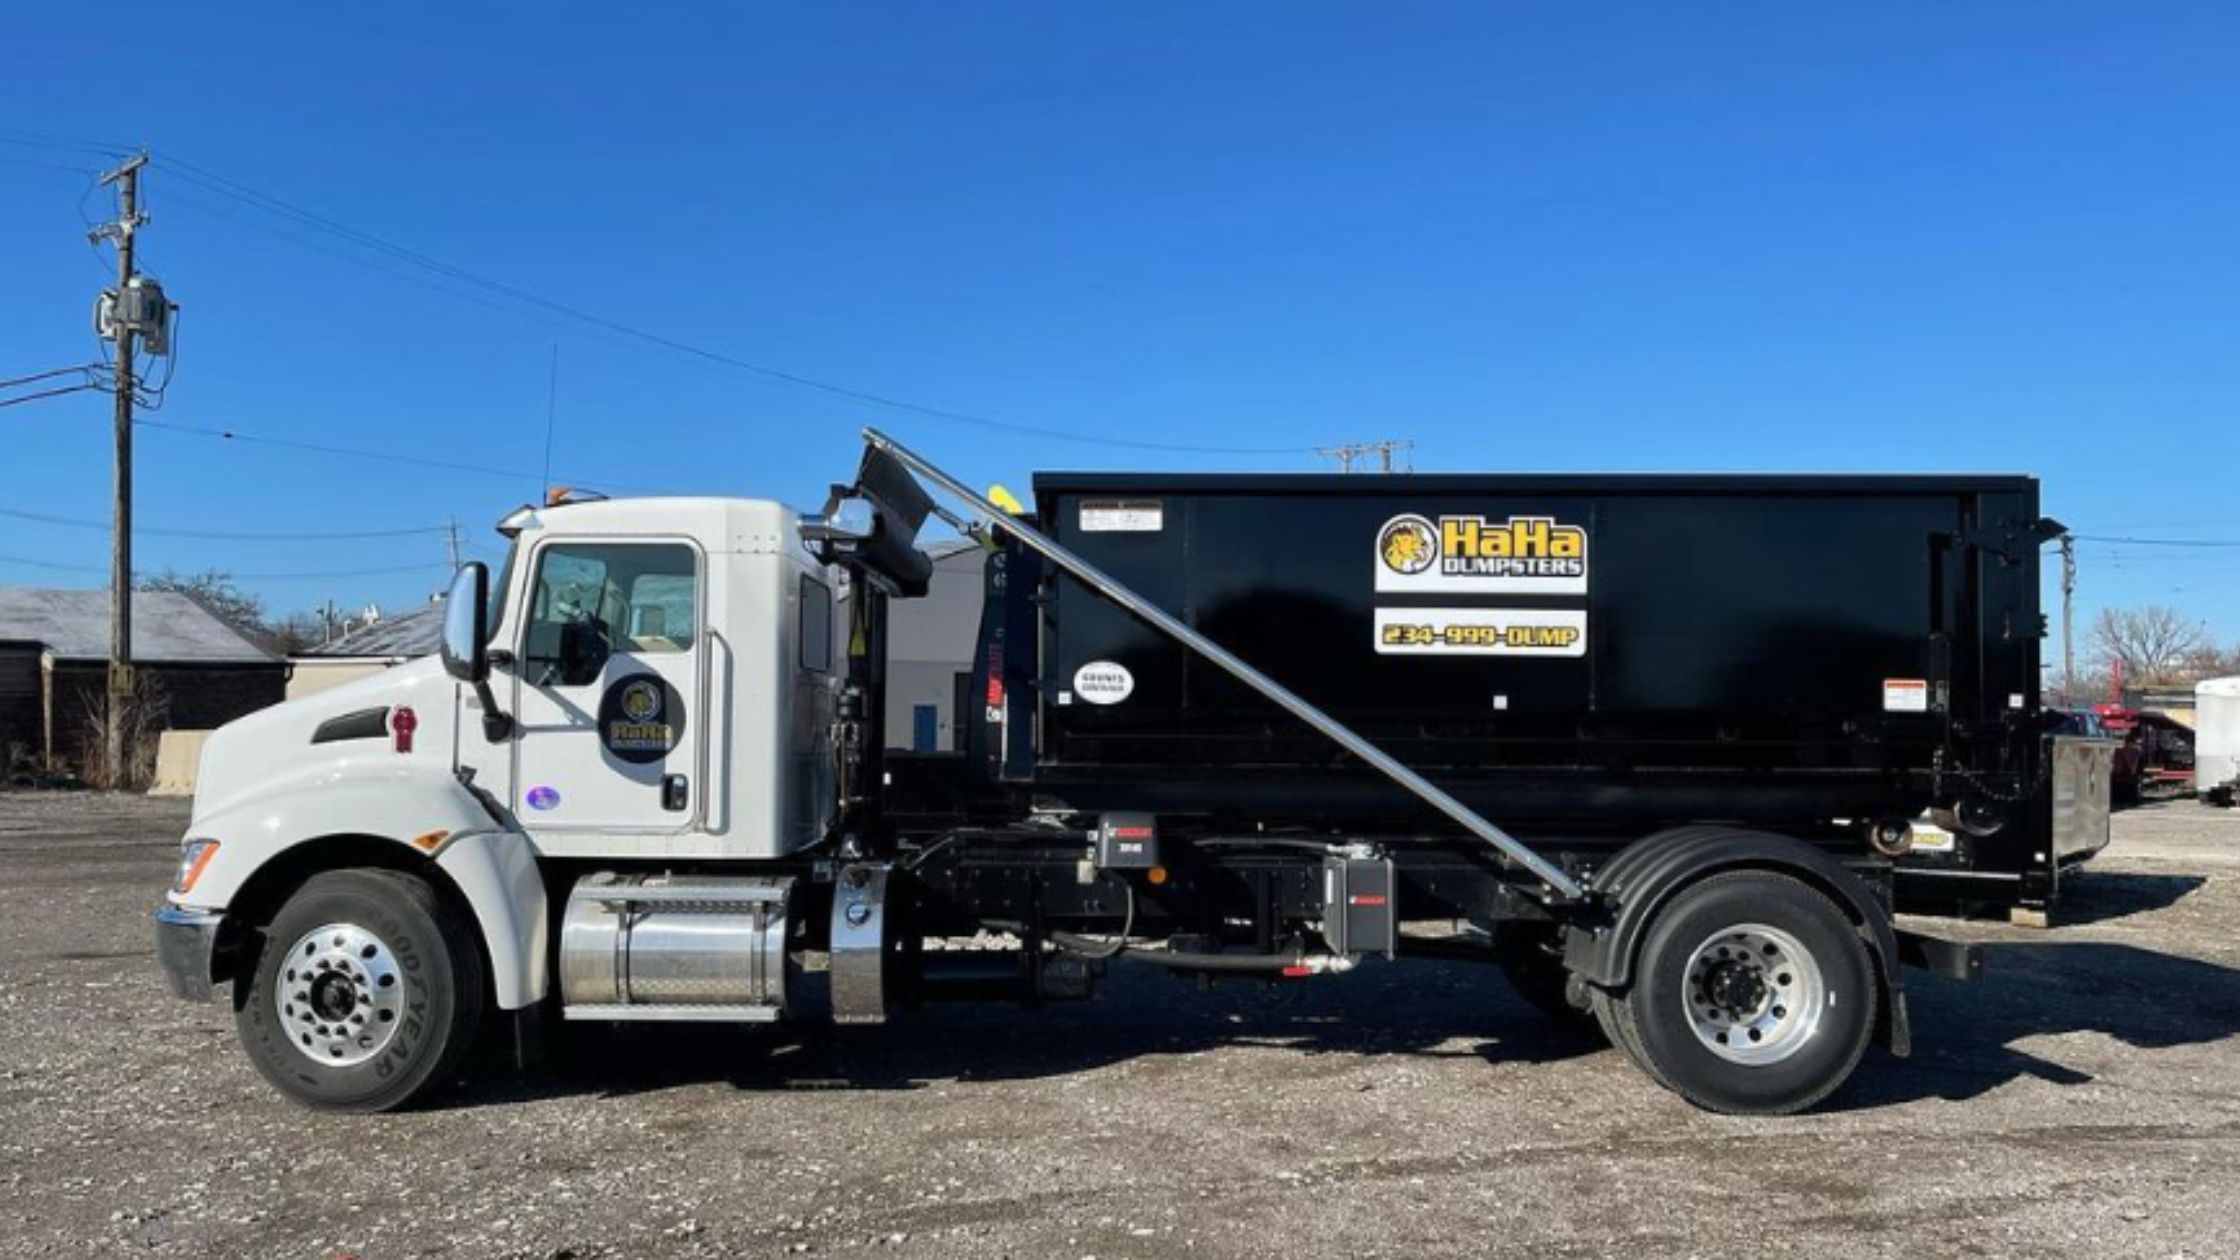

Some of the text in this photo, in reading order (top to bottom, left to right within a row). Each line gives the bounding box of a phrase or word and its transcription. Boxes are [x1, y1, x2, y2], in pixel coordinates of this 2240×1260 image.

[1441, 519, 1583, 558] HaHa
[1441, 558, 1583, 576] DUMPSTERS
[1381, 624, 1580, 647] 234-999-DUMP
